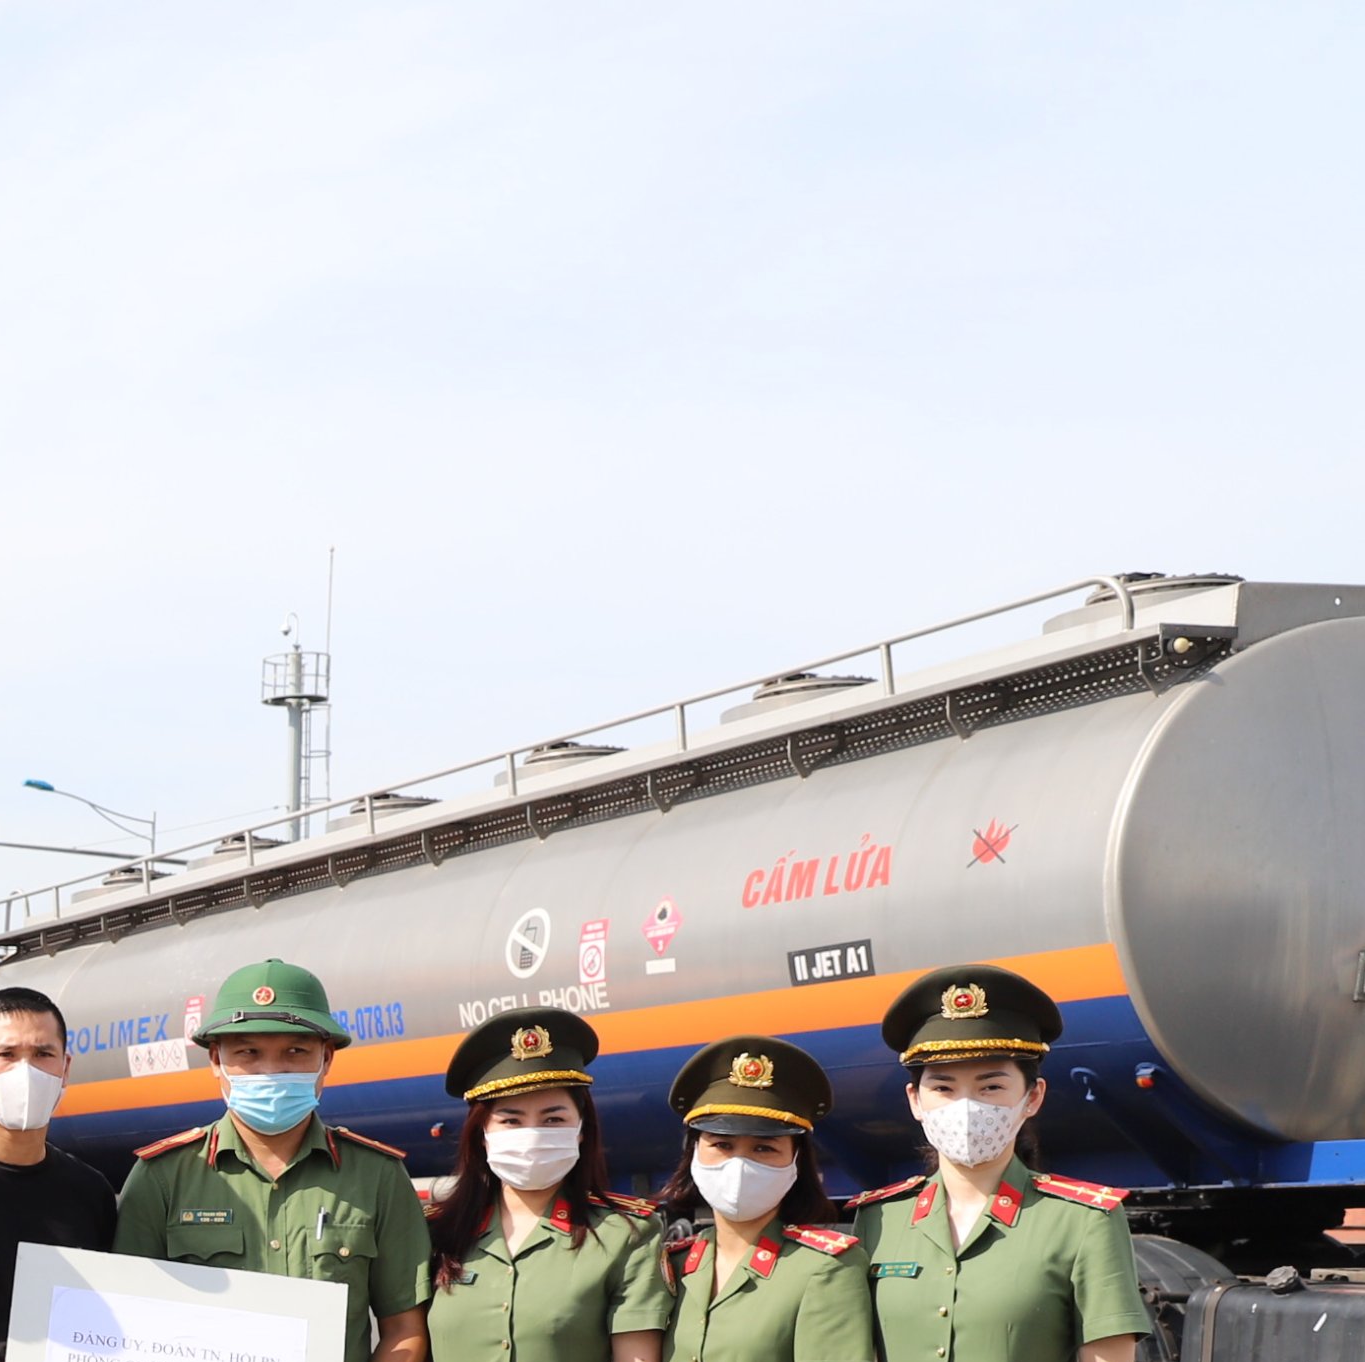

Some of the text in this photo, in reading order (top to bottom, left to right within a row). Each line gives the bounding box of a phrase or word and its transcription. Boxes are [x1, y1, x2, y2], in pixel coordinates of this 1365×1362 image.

[741, 833, 893, 909] CẤM LỬA
[811, 949, 842, 979] JET
[846, 945, 869, 974] A1
[458, 1000, 487, 1028] NO
[539, 982, 610, 1013] PHONE
[66, 1012, 169, 1055] ROLIMEX
[151, 1341, 196, 1358] ĐOÀN
